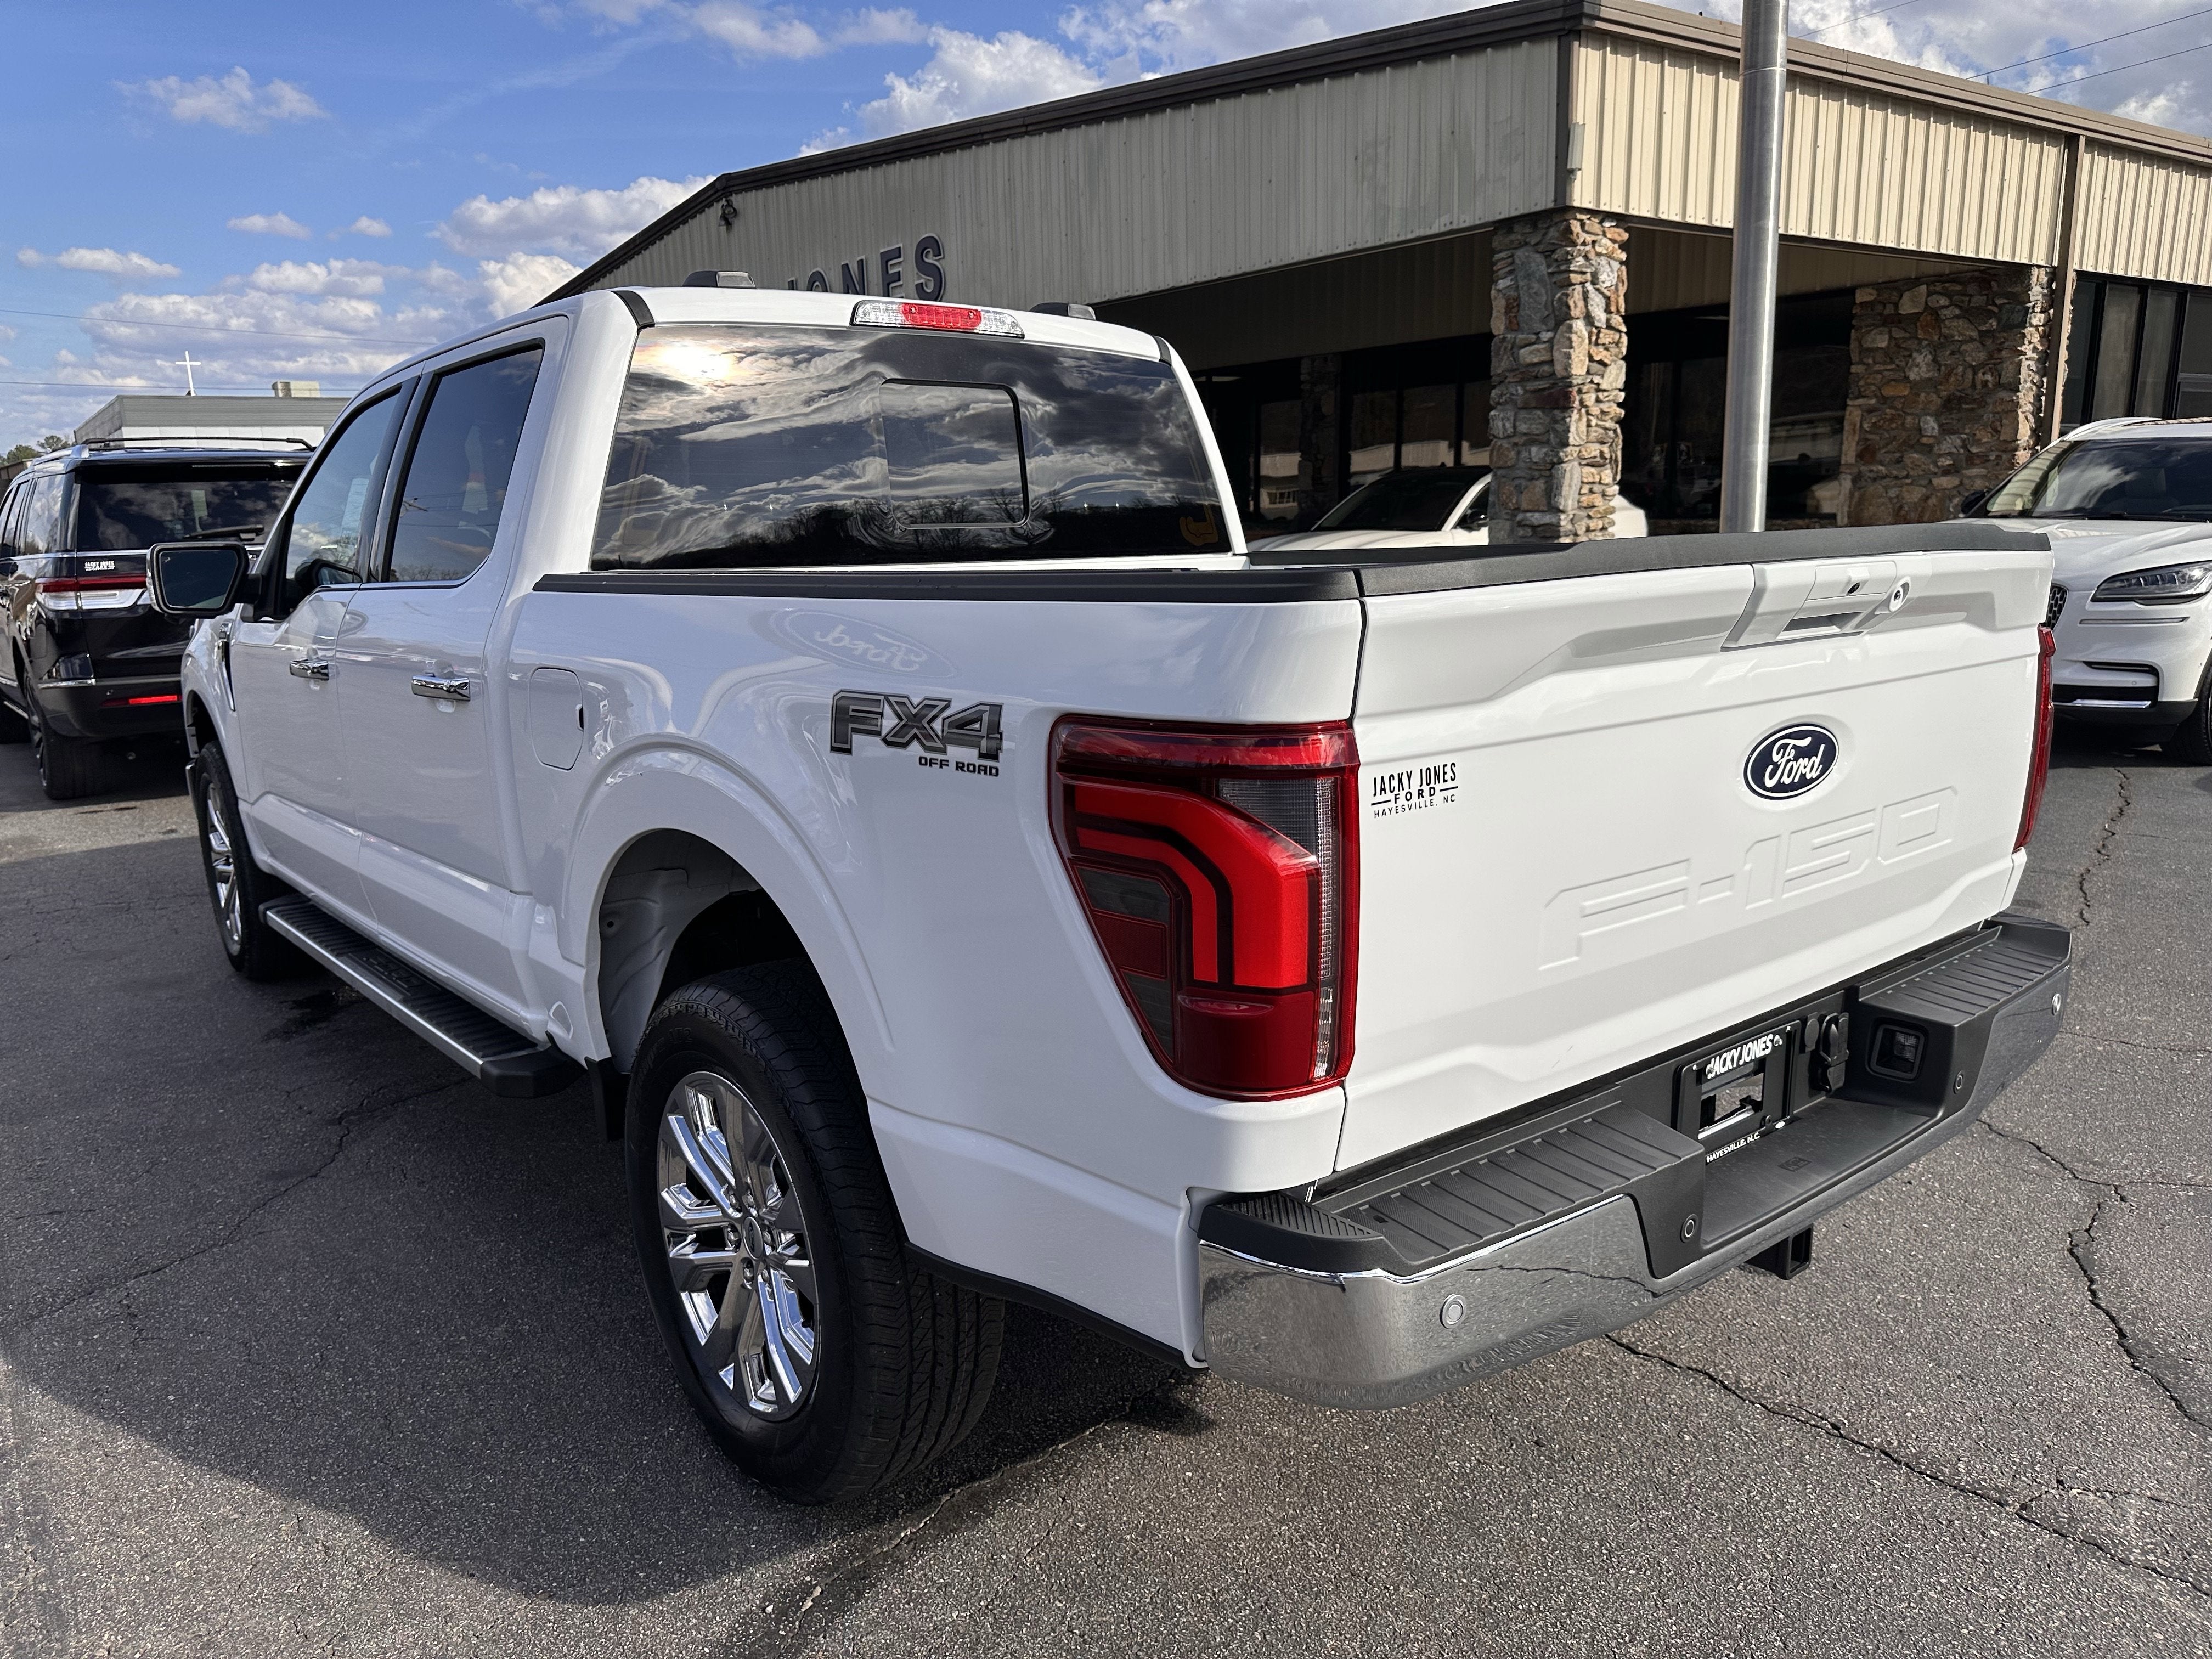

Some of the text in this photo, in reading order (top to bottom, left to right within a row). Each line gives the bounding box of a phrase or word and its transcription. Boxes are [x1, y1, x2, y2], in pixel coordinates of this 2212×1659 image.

[788, 233, 944, 302] NES
[830, 688, 1004, 762] FX4
[919, 756, 999, 777] OFF ROAD
[1373, 762, 1457, 797] JACKY JONES
[1764, 736, 1825, 788] Ford
[1374, 794, 1456, 819] HAYESVILLE, NC
[1394, 786, 1436, 804] FORD
[1538, 786, 1959, 971] F-150
[1707, 1034, 1773, 1080] JACKY JONES
[1707, 1132, 1761, 1163] HAYESVILLE, N.C.
